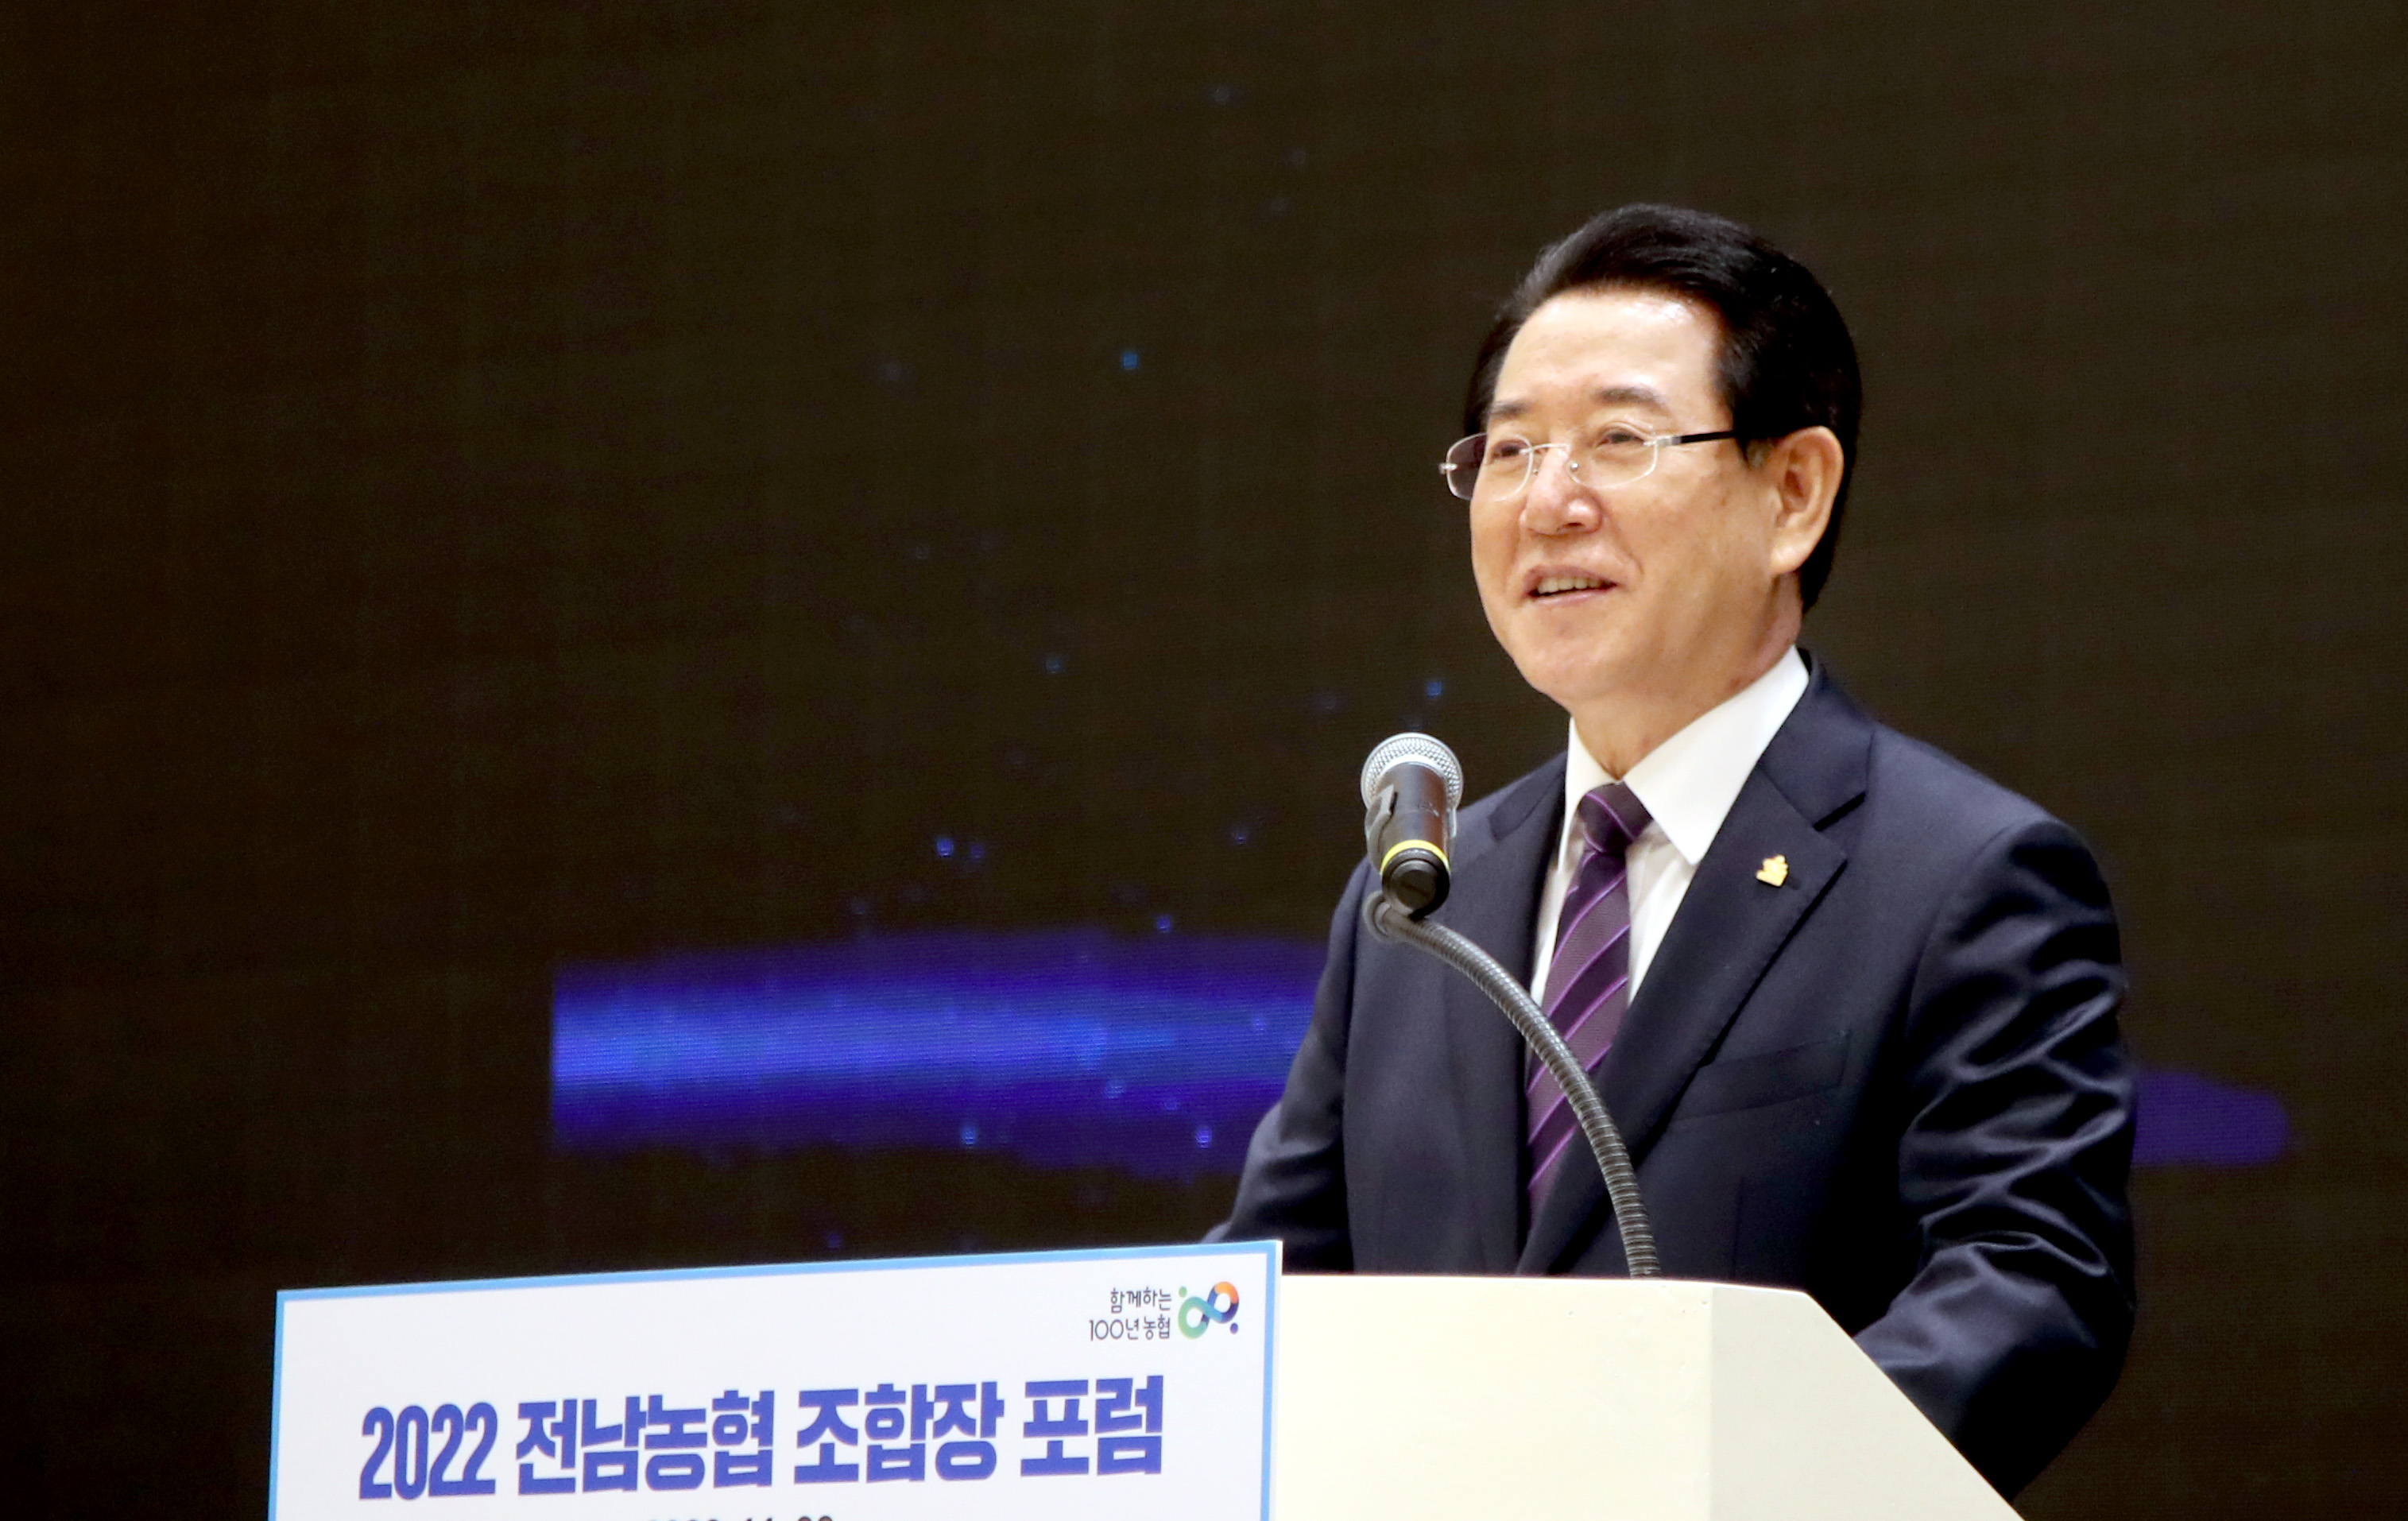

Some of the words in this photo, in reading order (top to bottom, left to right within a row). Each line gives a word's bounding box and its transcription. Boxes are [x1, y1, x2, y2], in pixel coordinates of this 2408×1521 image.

[1110, 1286, 1171, 1314] 함께하는
[1089, 1318, 1140, 1341] 100년
[1143, 1314, 1171, 1341] 농협
[359, 1401, 498, 1500] 2022
[516, 1389, 775, 1496] 전남농협
[794, 1381, 1005, 1484] 조합장
[1020, 1375, 1163, 1476] 포럼
